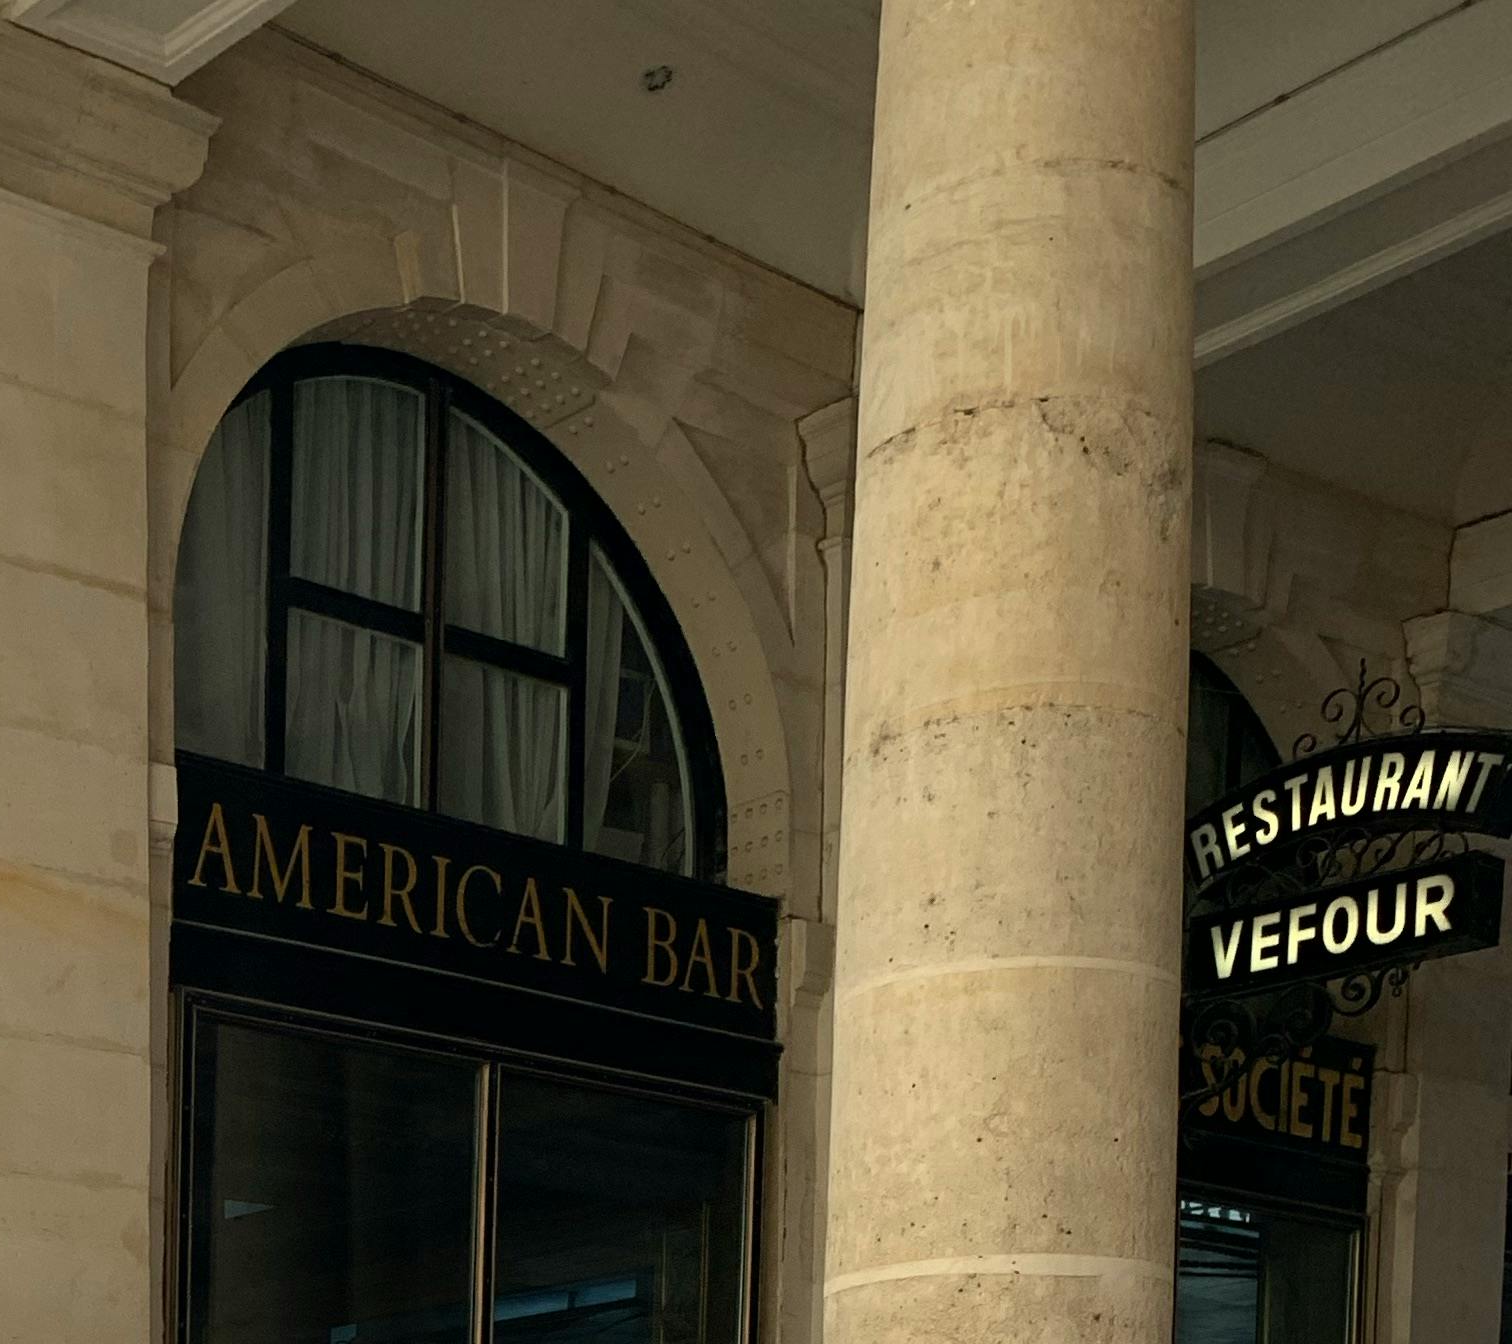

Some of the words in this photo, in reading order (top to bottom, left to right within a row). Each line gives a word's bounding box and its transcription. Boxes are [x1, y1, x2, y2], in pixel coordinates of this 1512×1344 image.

[1190, 750, 1505, 880] RESTAURANT
[187, 801, 613, 975] AMERICAN
[640, 905, 764, 1010] BAR
[1211, 873, 1455, 980] VEFOUR
[1198, 1043, 1366, 1149] SOCIÉTÉ
